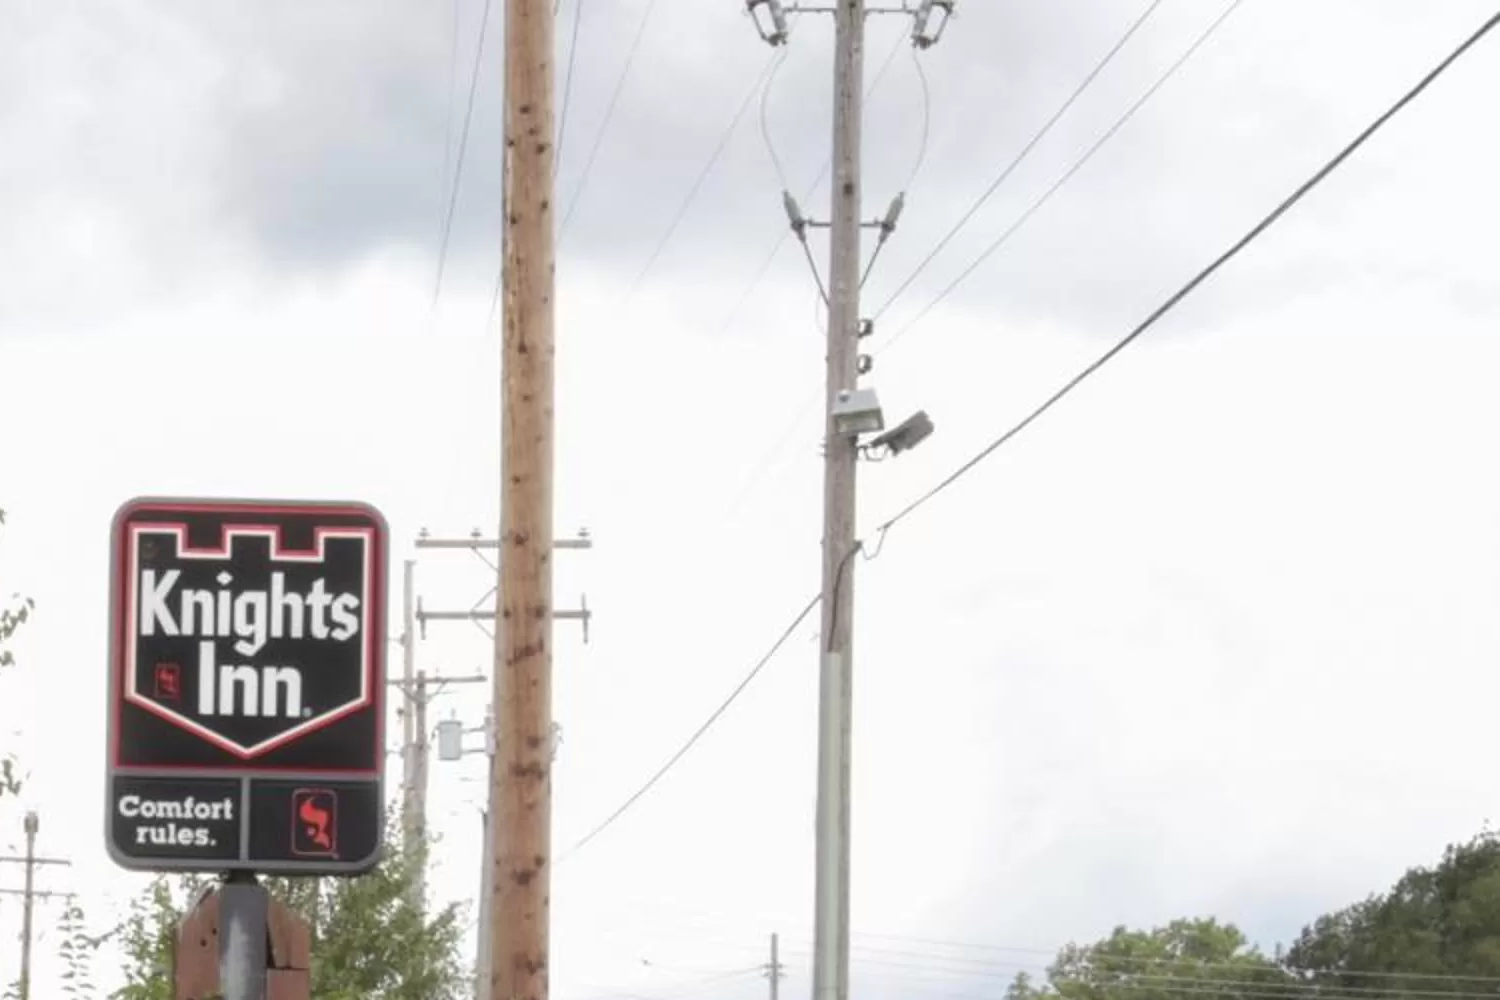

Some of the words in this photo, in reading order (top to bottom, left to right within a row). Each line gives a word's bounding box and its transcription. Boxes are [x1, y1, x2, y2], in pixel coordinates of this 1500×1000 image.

[140, 569, 360, 657] Knights
[119, 795, 233, 820] Comfort
[135, 823, 217, 846] rules.
